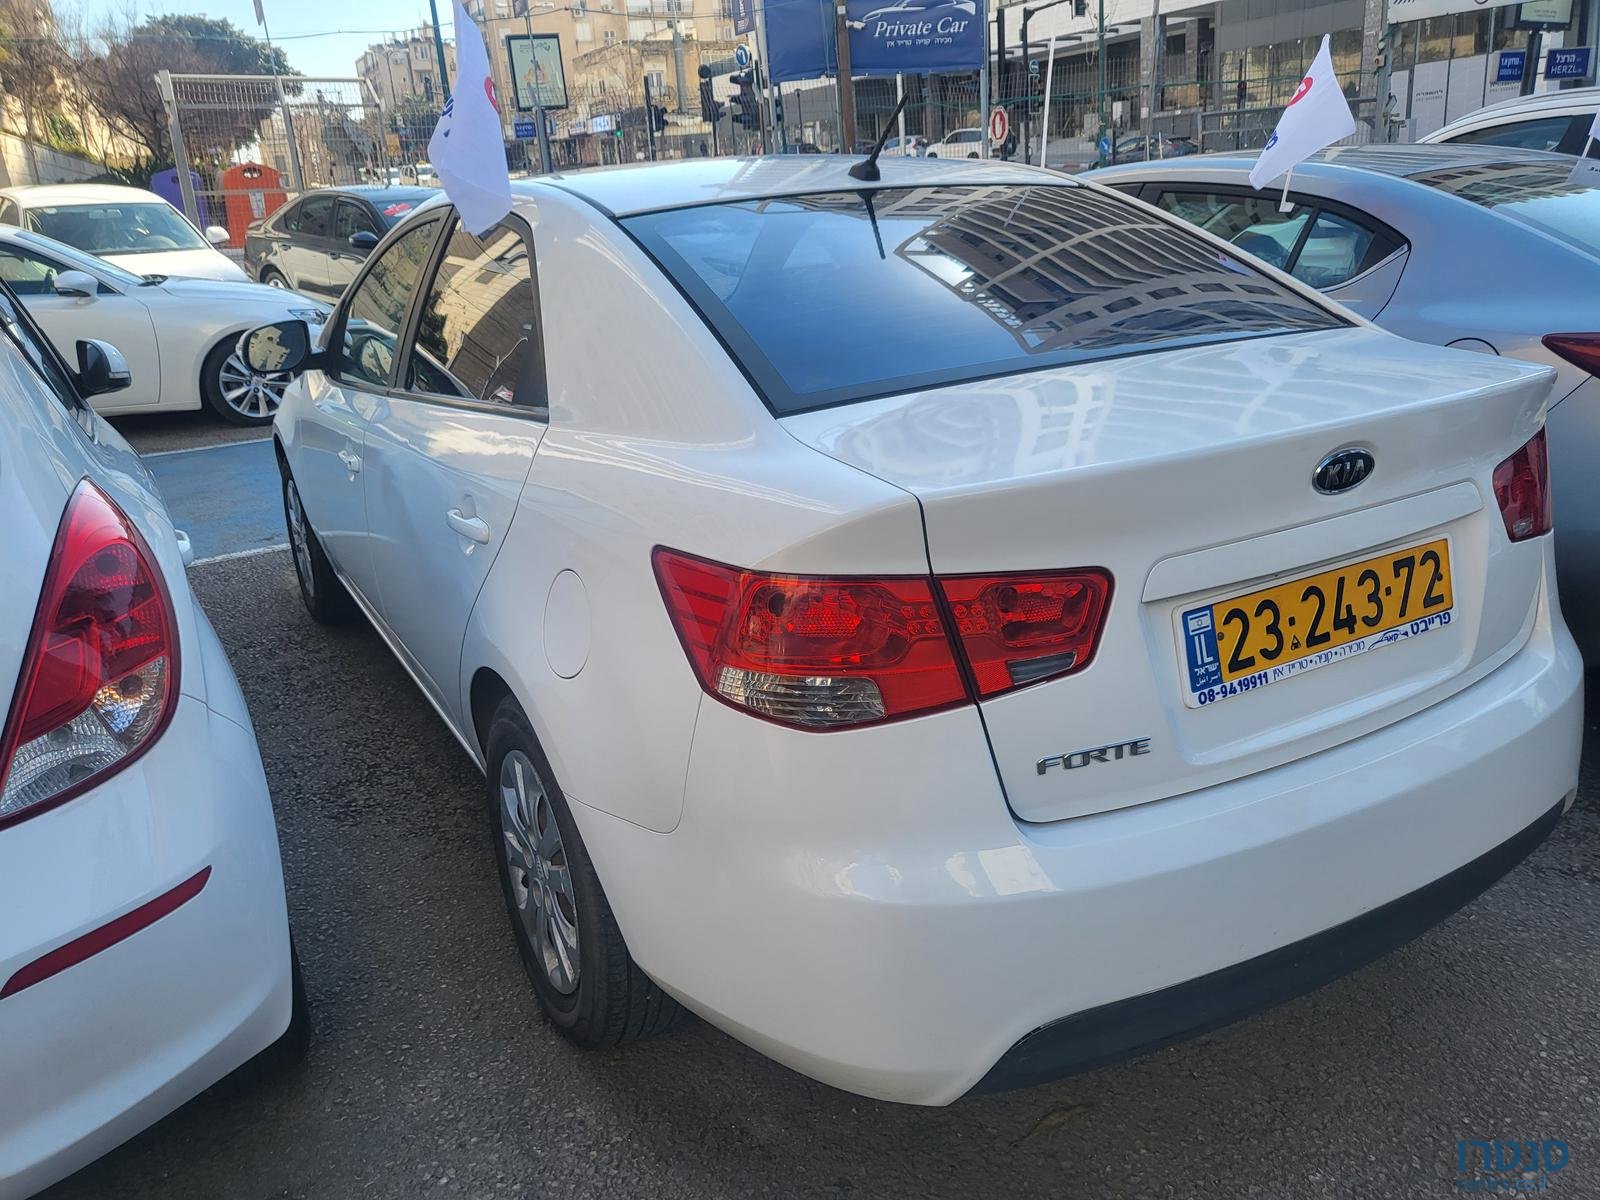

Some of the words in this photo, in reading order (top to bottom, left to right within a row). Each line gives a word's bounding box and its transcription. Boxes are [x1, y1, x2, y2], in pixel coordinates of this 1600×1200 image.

[874, 20, 932, 38] Private
[937, 16, 968, 33] Car
[1556, 54, 1576, 63] הרצל
[1550, 64, 1577, 74] HERZL
[1325, 458, 1365, 489] KIA
[1410, 612, 1451, 634] פרייבט
[1384, 633, 1398, 642] קאר
[1194, 634, 1214, 665] IL
[1340, 640, 1365, 656] מכירה
[1194, 662, 1218, 675] ישראל
[1273, 668, 1284, 680] אין
[1285, 659, 1308, 673] טרייד
[1198, 672, 1268, 704] 08-9419911
[1036, 736, 1152, 775] FORTE
